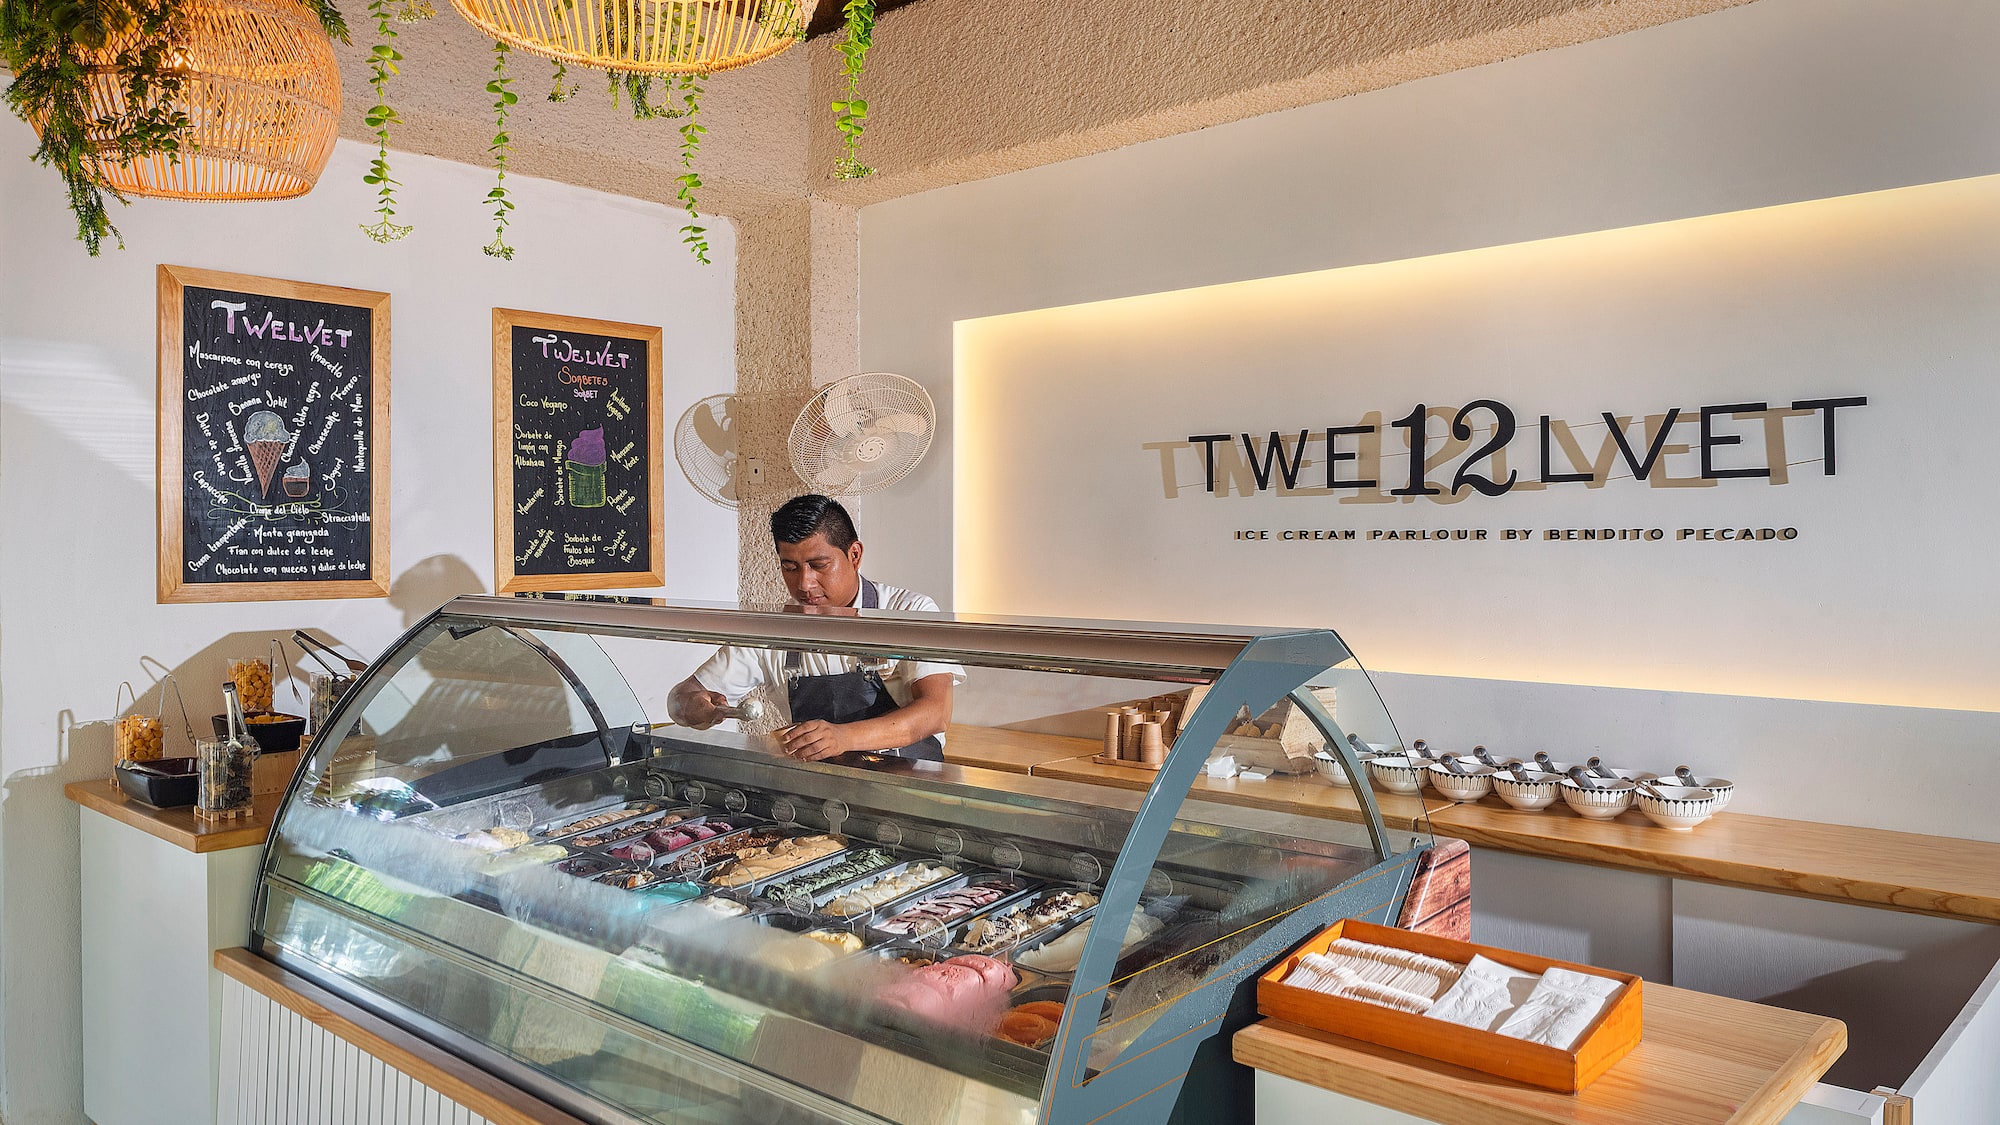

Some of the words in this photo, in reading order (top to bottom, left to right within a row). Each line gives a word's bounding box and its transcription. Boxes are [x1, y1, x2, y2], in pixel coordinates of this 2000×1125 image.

[211, 300, 352, 348] TWELVET
[189, 340, 242, 369] Mascarpone
[246, 359, 260, 369] con
[310, 345, 343, 378] Amaretto
[532, 334, 629, 369] TWELVET
[188, 382, 230, 401] Chocolate
[231, 372, 261, 386] amargo
[228, 397, 262, 415] Banana
[265, 390, 288, 408] Split
[519, 393, 539, 407] Coco
[541, 395, 568, 416] Vegano
[196, 412, 211, 437] Dulce
[281, 429, 301, 462] Chocolate
[292, 406, 309, 427] Selva
[306, 381, 321, 403] negra
[353, 416, 363, 428] de
[514, 423, 542, 439] Sorbete
[544, 431, 552, 439] de
[308, 411, 340, 454] Cheesecake
[208, 439, 218, 451] de
[538, 444, 549, 454] con
[552, 439, 567, 464] Mango
[212, 451, 226, 476] leche
[322, 457, 345, 491] Yogurt
[556, 465, 563, 476] de
[274, 504, 286, 514] del
[290, 503, 309, 514] Cielo
[253, 524, 283, 544] Menta
[286, 527, 329, 544] granizada
[564, 532, 590, 543] Sorbete
[592, 533, 602, 542] de
[603, 529, 626, 557] Sorbete
[1237, 530, 1269, 540] ICE
[1283, 530, 1356, 540] CREAM
[1372, 529, 1488, 540] PARLOUR
[1506, 528, 1533, 540] BY
[1550, 528, 1664, 540] BENDITO
[1683, 527, 1798, 540] PECADO
[267, 546, 290, 556] dulce
[294, 546, 306, 555] de
[311, 546, 334, 557] leche
[515, 539, 540, 566] Sorbete
[536, 528, 546, 538] de
[583, 545, 595, 553] del
[620, 541, 628, 551] de
[188, 554, 211, 571] Crema
[215, 563, 258, 575] Chocolate
[263, 565, 277, 575] con
[281, 565, 308, 574] nueces
[311, 565, 316, 575] y
[318, 563, 336, 572] dulce
[338, 562, 346, 570] de
[348, 560, 366, 571] leche
[567, 555, 595, 567] Bosque
